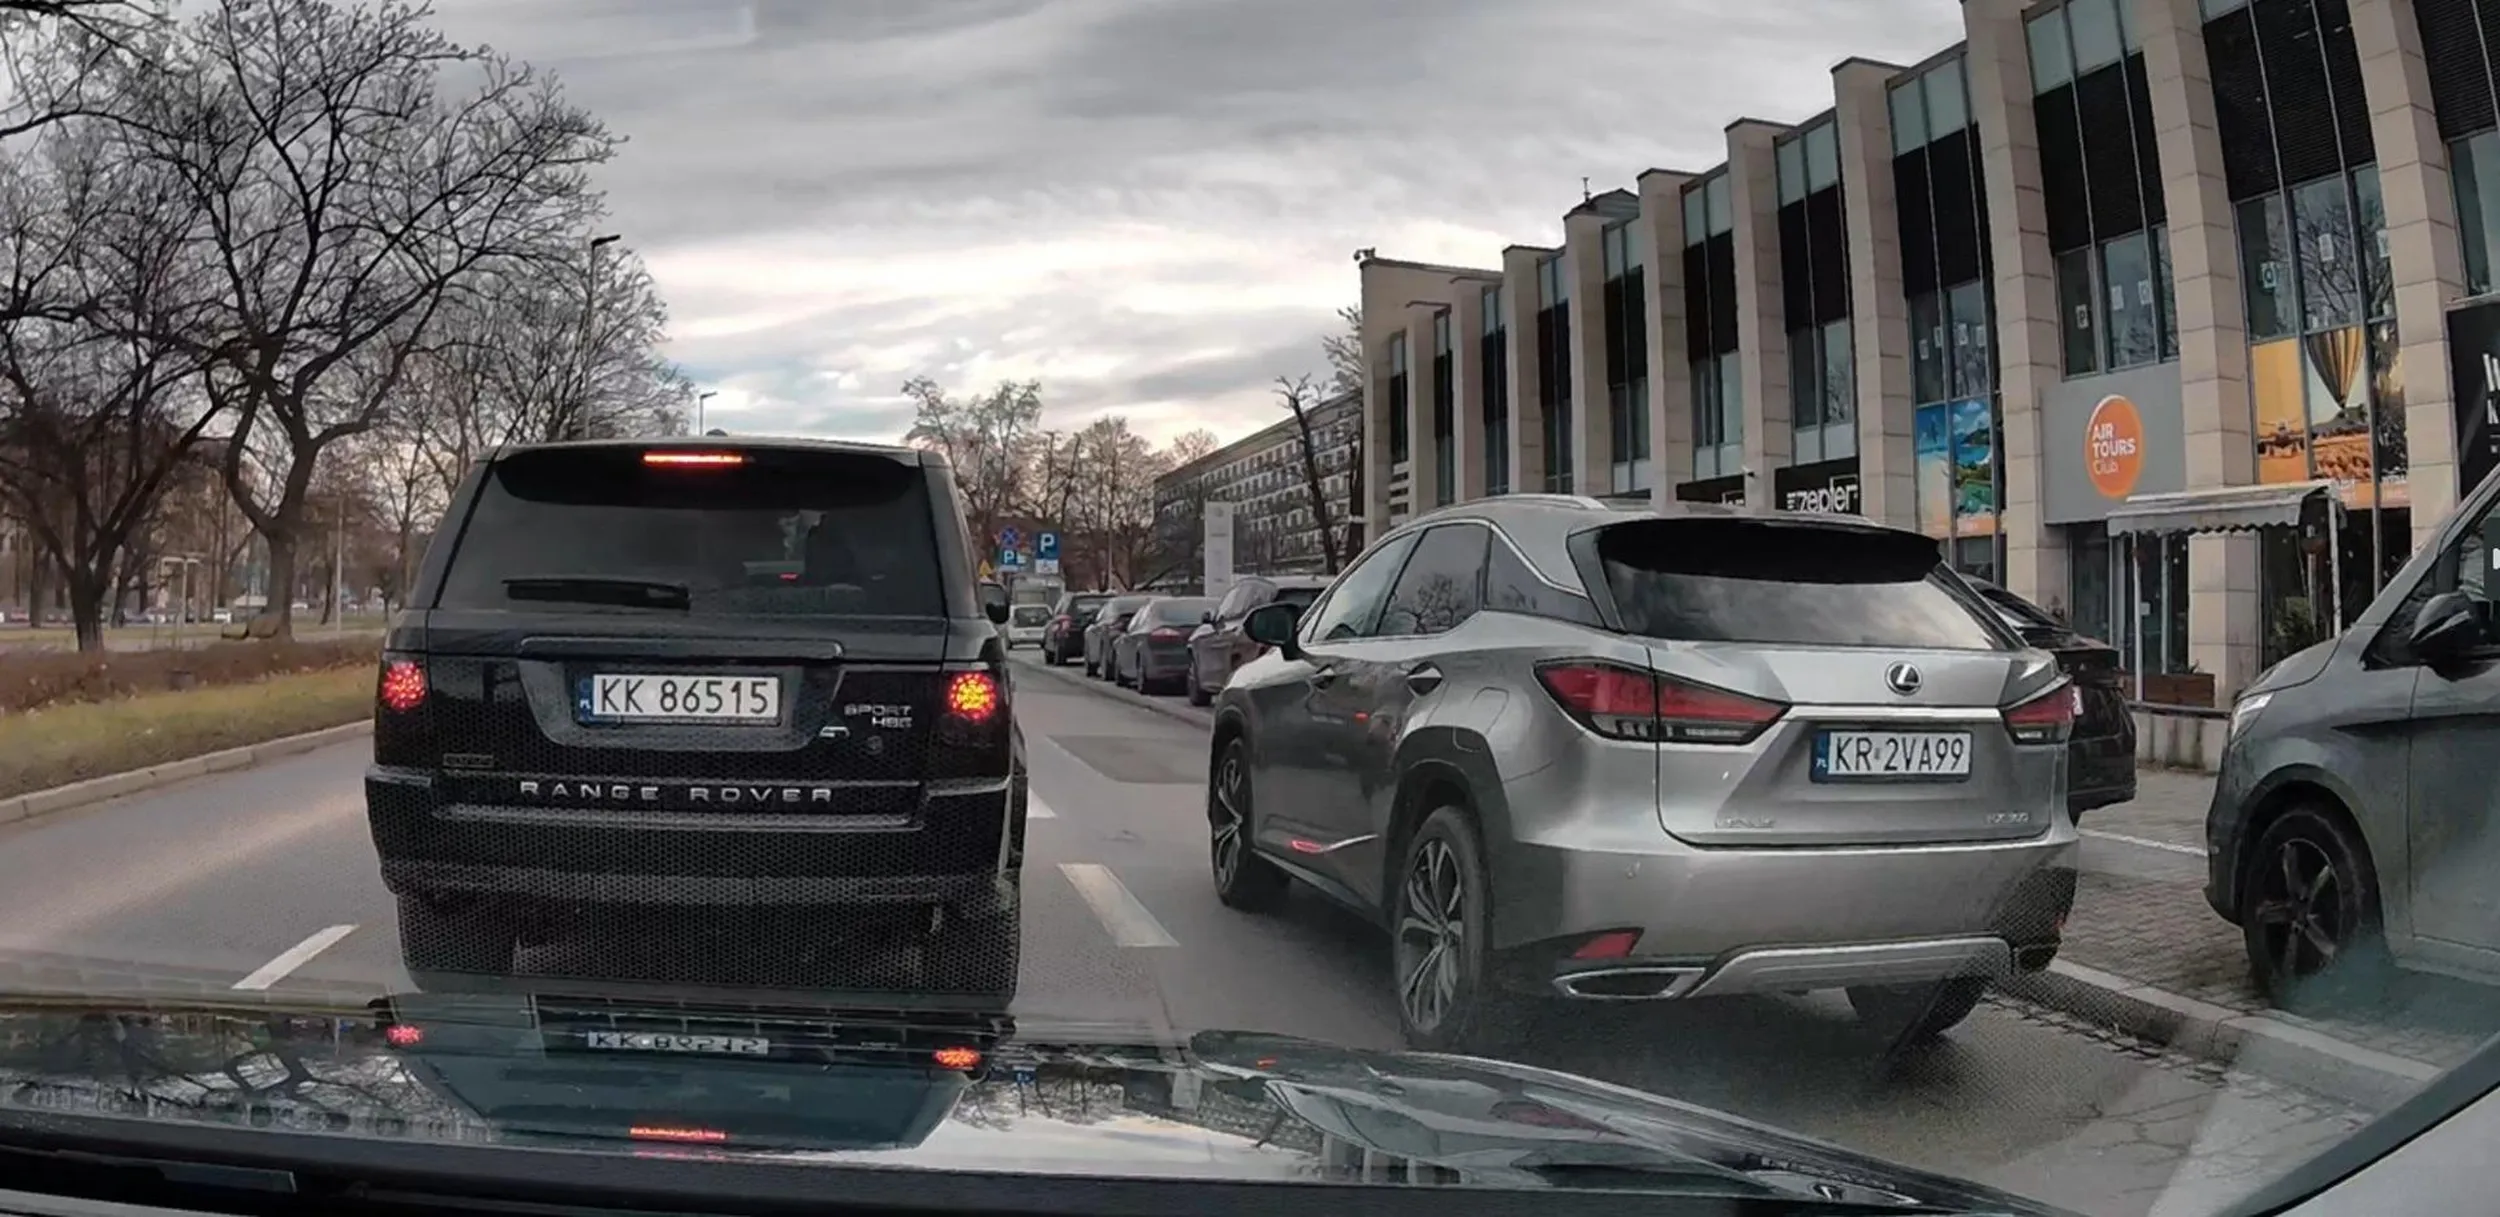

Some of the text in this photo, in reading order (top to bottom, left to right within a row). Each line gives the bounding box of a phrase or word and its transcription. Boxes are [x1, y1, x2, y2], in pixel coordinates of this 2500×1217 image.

[2092, 422, 2113, 440] AIR
[2092, 437, 2136, 458] TOURS
[2093, 459, 2119, 475] Club
[1040, 533, 1055, 552] P
[601, 678, 769, 714] KK 86515
[843, 703, 913, 716] SPORT
[1835, 736, 1965, 772] KR 2VA99
[519, 780, 833, 803] RANGE ROVER
